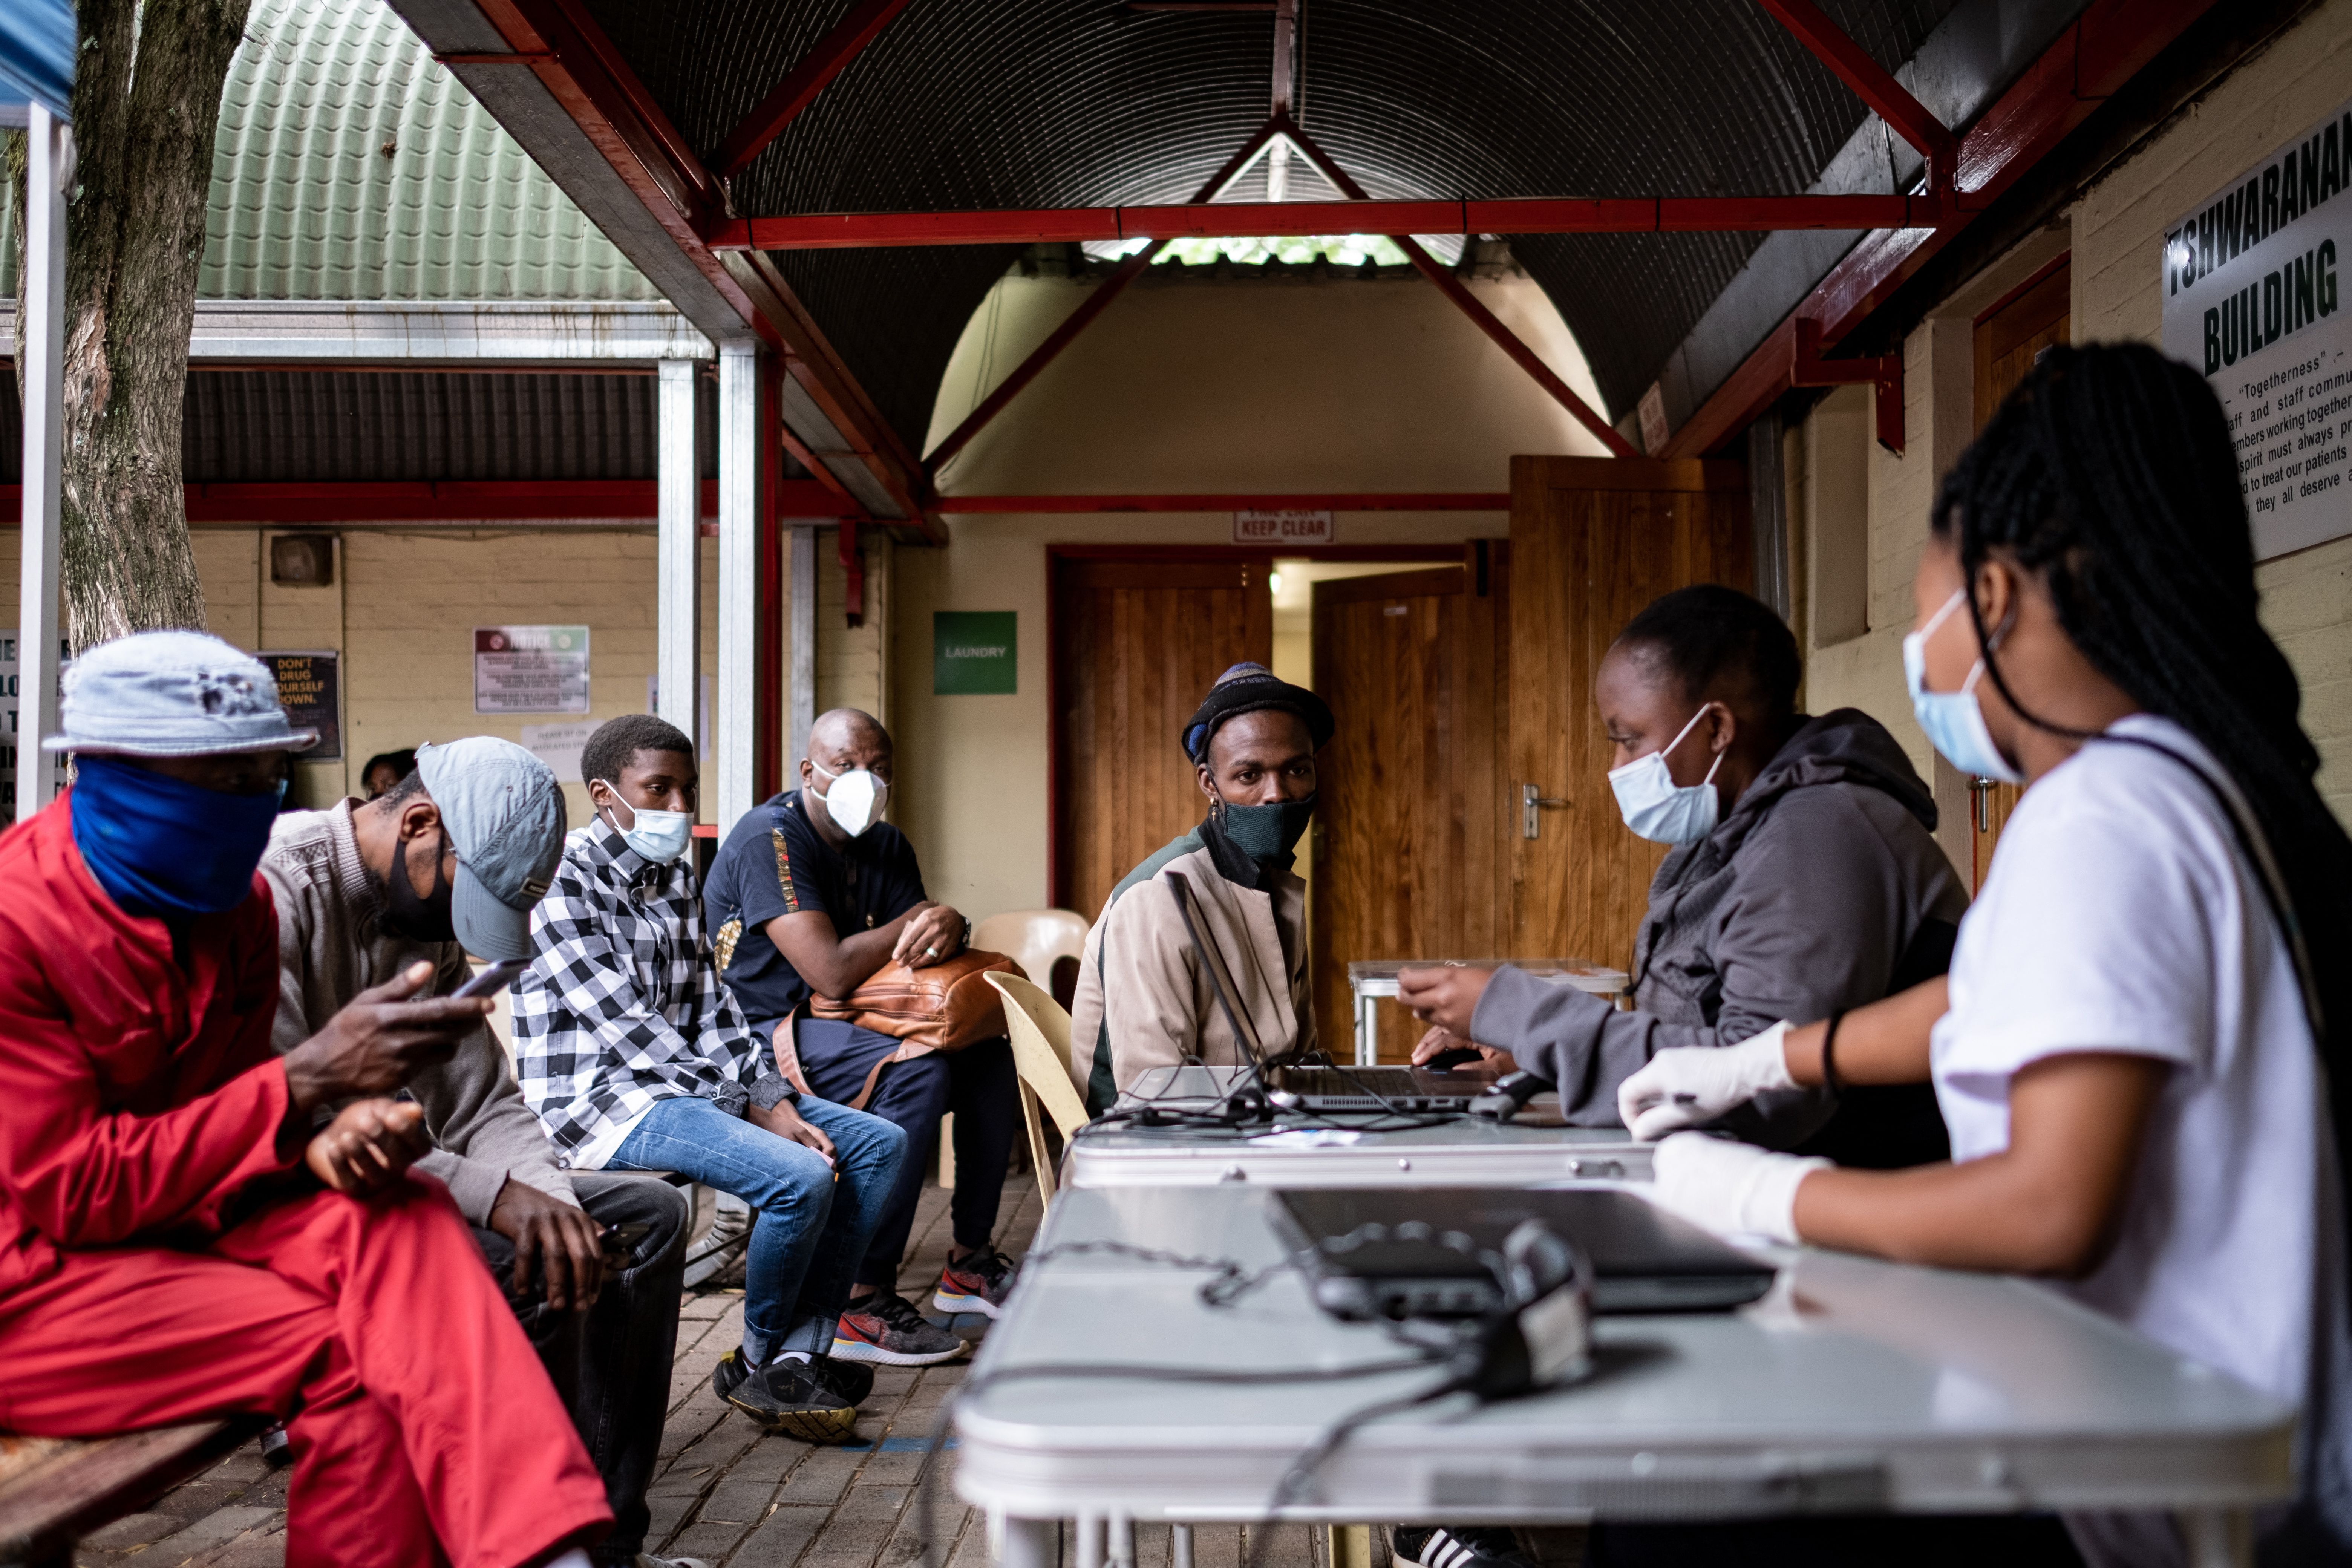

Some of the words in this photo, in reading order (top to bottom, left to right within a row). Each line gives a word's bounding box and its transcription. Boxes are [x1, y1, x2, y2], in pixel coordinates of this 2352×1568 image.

[2204, 239, 2337, 377] BUILDING
[2250, 401, 2269, 423] and
[2278, 386, 2304, 411] staff
[2231, 429, 2265, 452] embers
[2266, 414, 2305, 439] working
[2306, 395, 2352, 423] together
[2239, 451, 2263, 475] spirit
[2268, 439, 2292, 462] must
[2298, 426, 2333, 450] always
[2251, 476, 2260, 491] to
[2262, 467, 2283, 487] treat
[2286, 461, 2302, 478] our
[2305, 445, 2347, 476] patients
[2256, 496, 2275, 513] they
[2282, 485, 2293, 504] all
[2300, 473, 2340, 498] deserve
[1243, 520, 1277, 536] KEEP
[1282, 520, 1325, 536] CLEAR
[278, 658, 312, 669] DON'T
[945, 646, 1006, 658] LAUNDRY
[277, 680, 324, 692] OURSELF
[279, 669, 311, 681] DRUG
[537, 731, 562, 740] PLEASE
